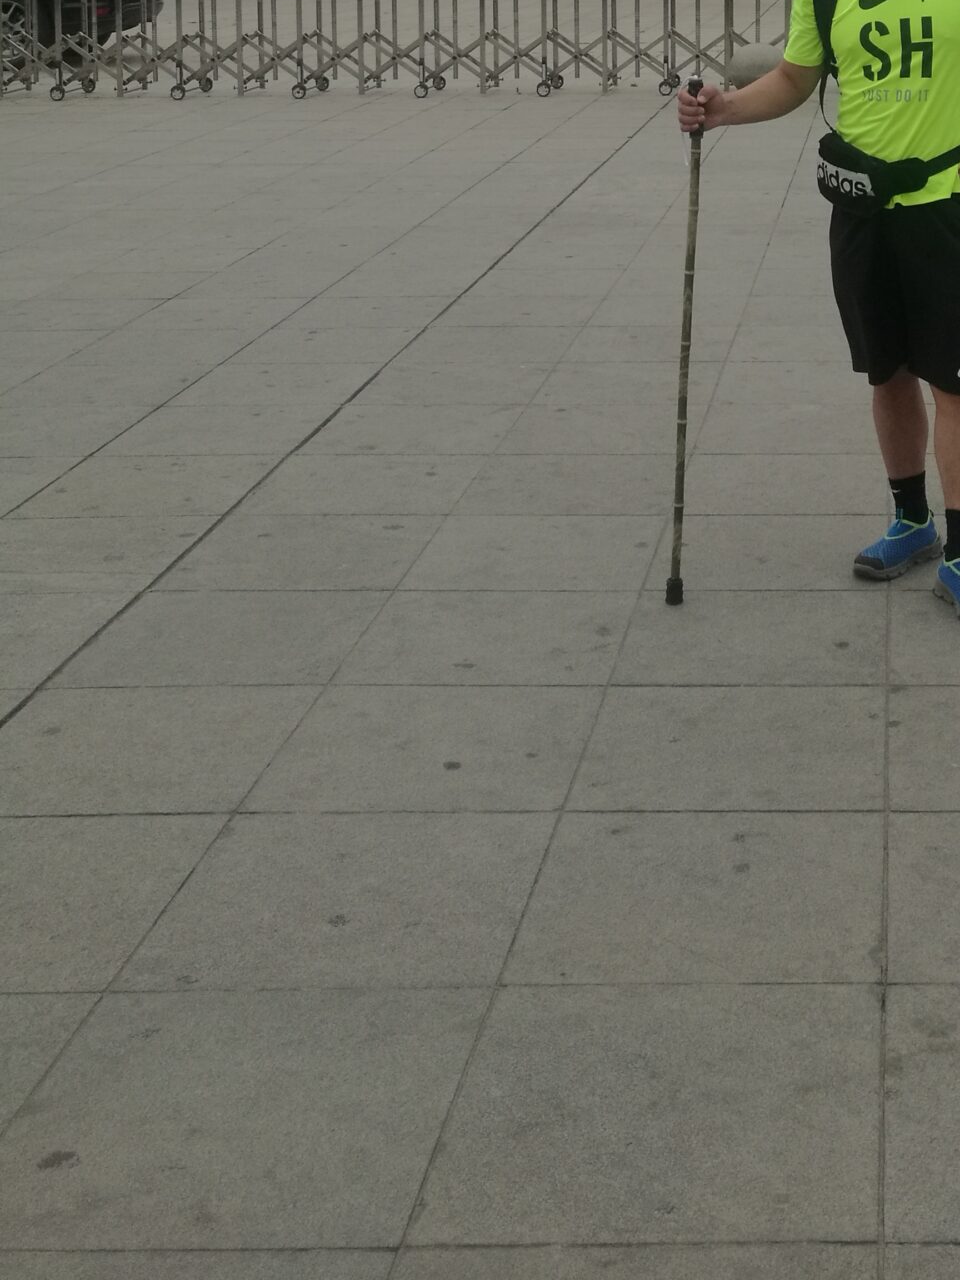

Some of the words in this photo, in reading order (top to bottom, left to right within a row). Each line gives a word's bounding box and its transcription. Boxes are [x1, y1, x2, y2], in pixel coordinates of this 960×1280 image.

[859, 16, 934, 82] SH
[895, 89, 912, 103] DO
[918, 89, 930, 102] IT
